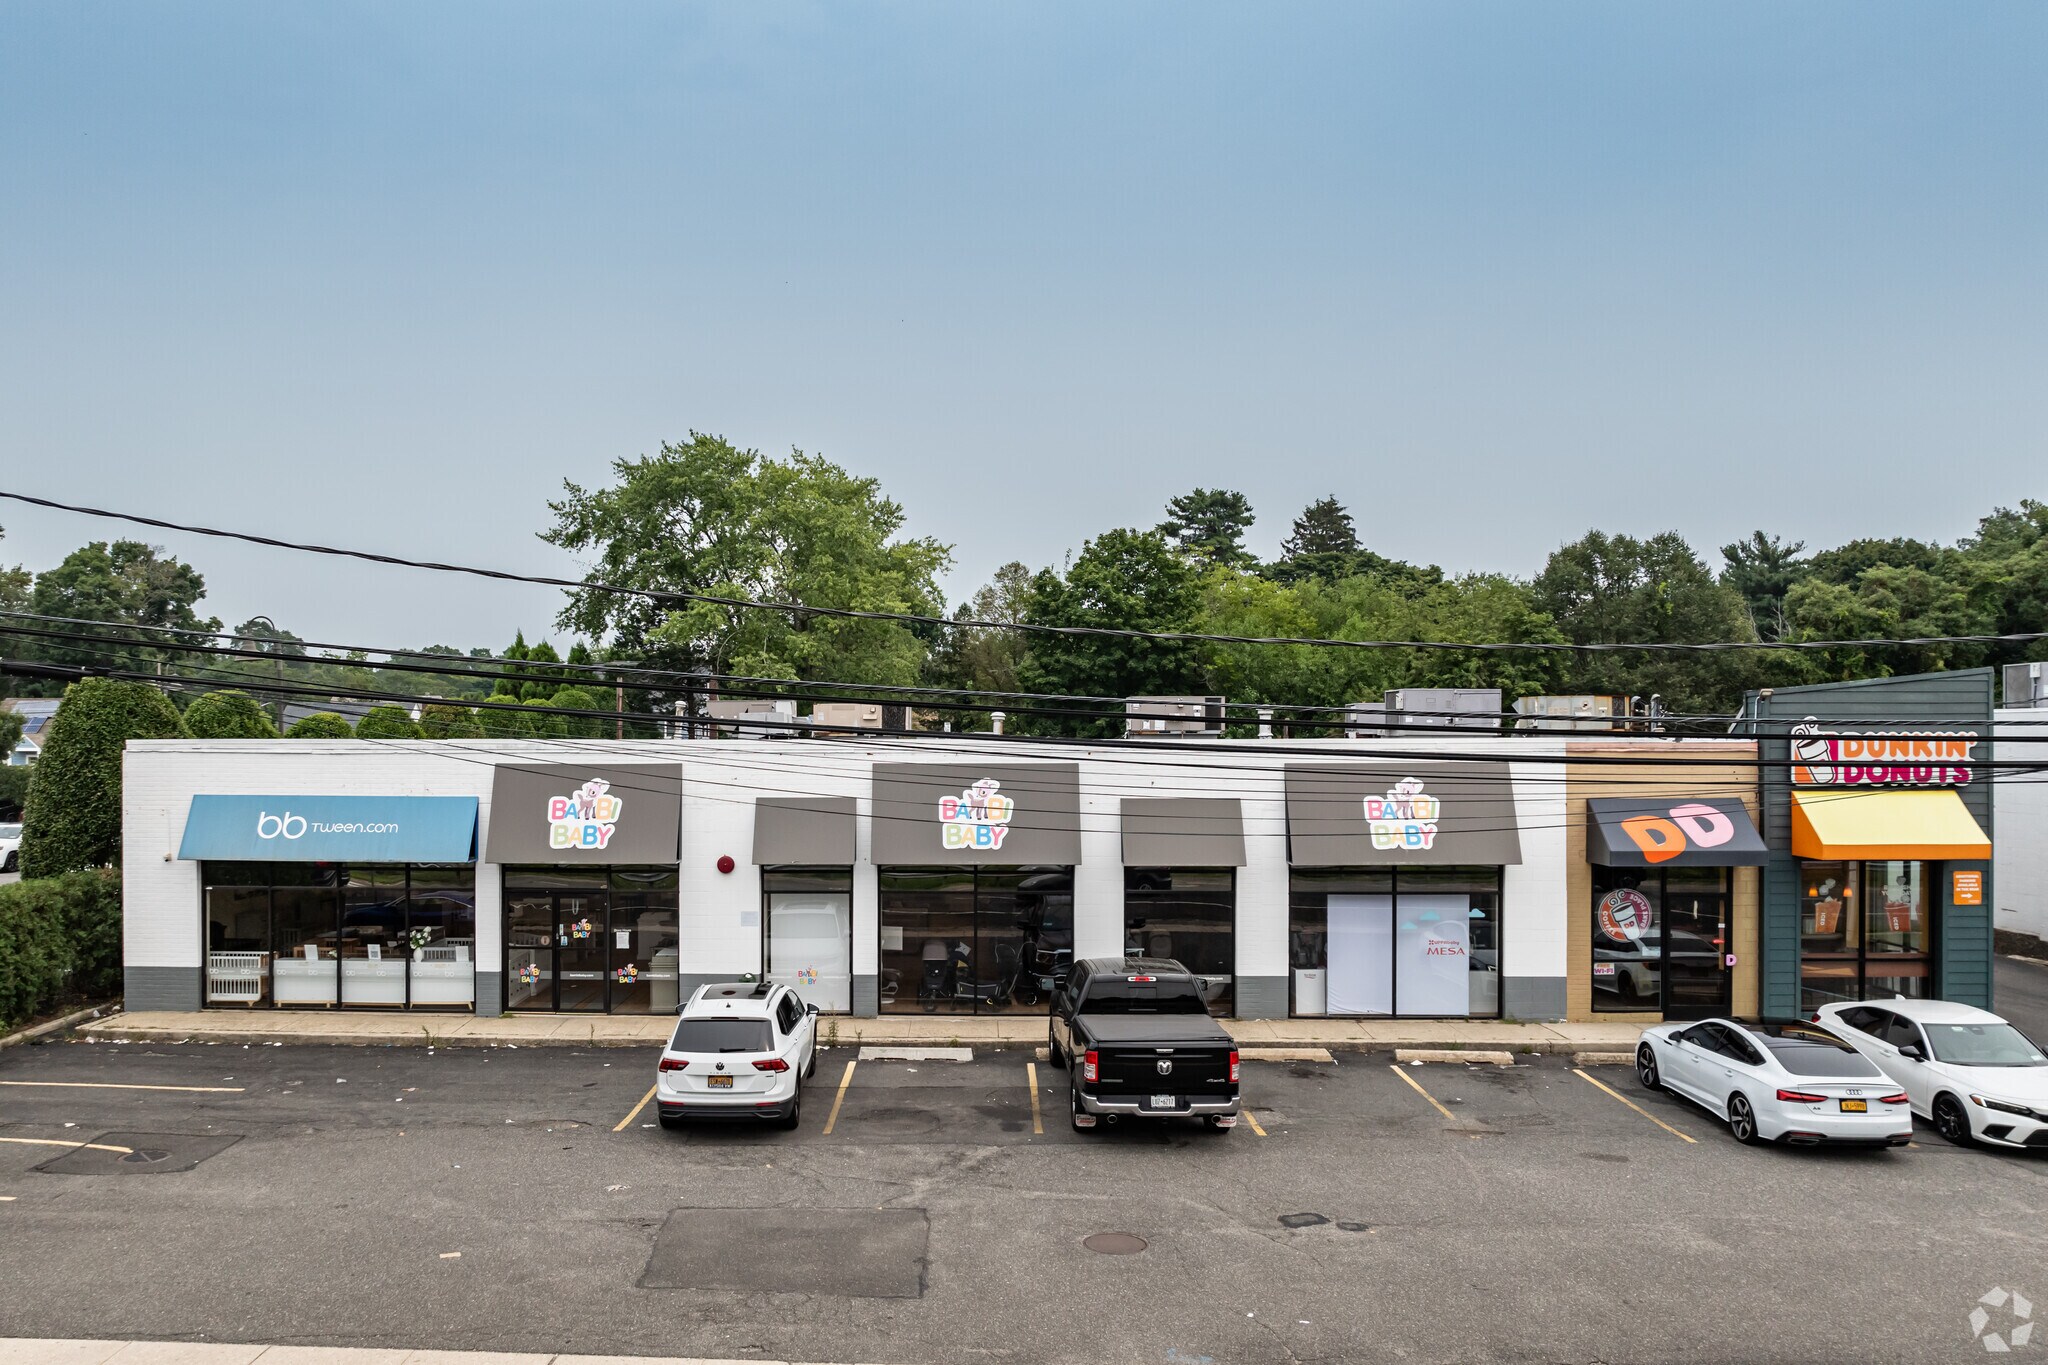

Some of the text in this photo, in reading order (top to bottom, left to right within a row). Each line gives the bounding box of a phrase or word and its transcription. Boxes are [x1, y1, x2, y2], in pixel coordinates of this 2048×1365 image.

[1843, 759, 1970, 784] DONUTS
[257, 811, 307, 839] bb
[553, 825, 611, 845] BABY
[1374, 824, 1434, 846] BABY
[946, 825, 1005, 846] BABY
[1624, 920, 1635, 929] DD
[1427, 947, 1465, 955] MESA
[619, 976, 636, 984] BABY
